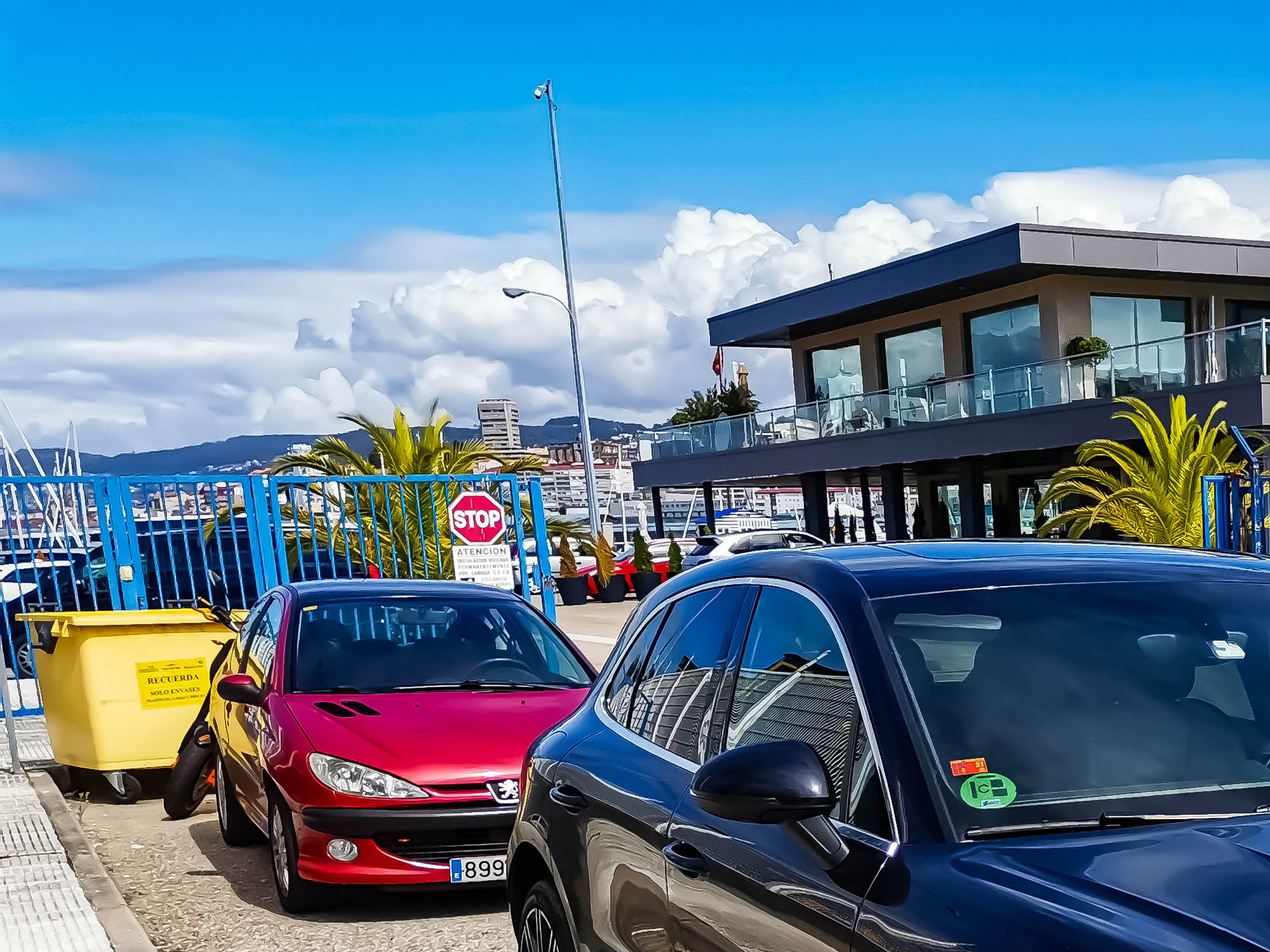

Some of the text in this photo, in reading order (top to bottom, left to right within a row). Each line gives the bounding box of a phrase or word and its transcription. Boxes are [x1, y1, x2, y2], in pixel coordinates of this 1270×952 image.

[453, 509, 501, 529] STOP
[457, 547, 507, 556] ATENCION
[147, 673, 200, 685] RECUERDA
[170, 686, 201, 695] ENVASES
[465, 859, 507, 878] 899
